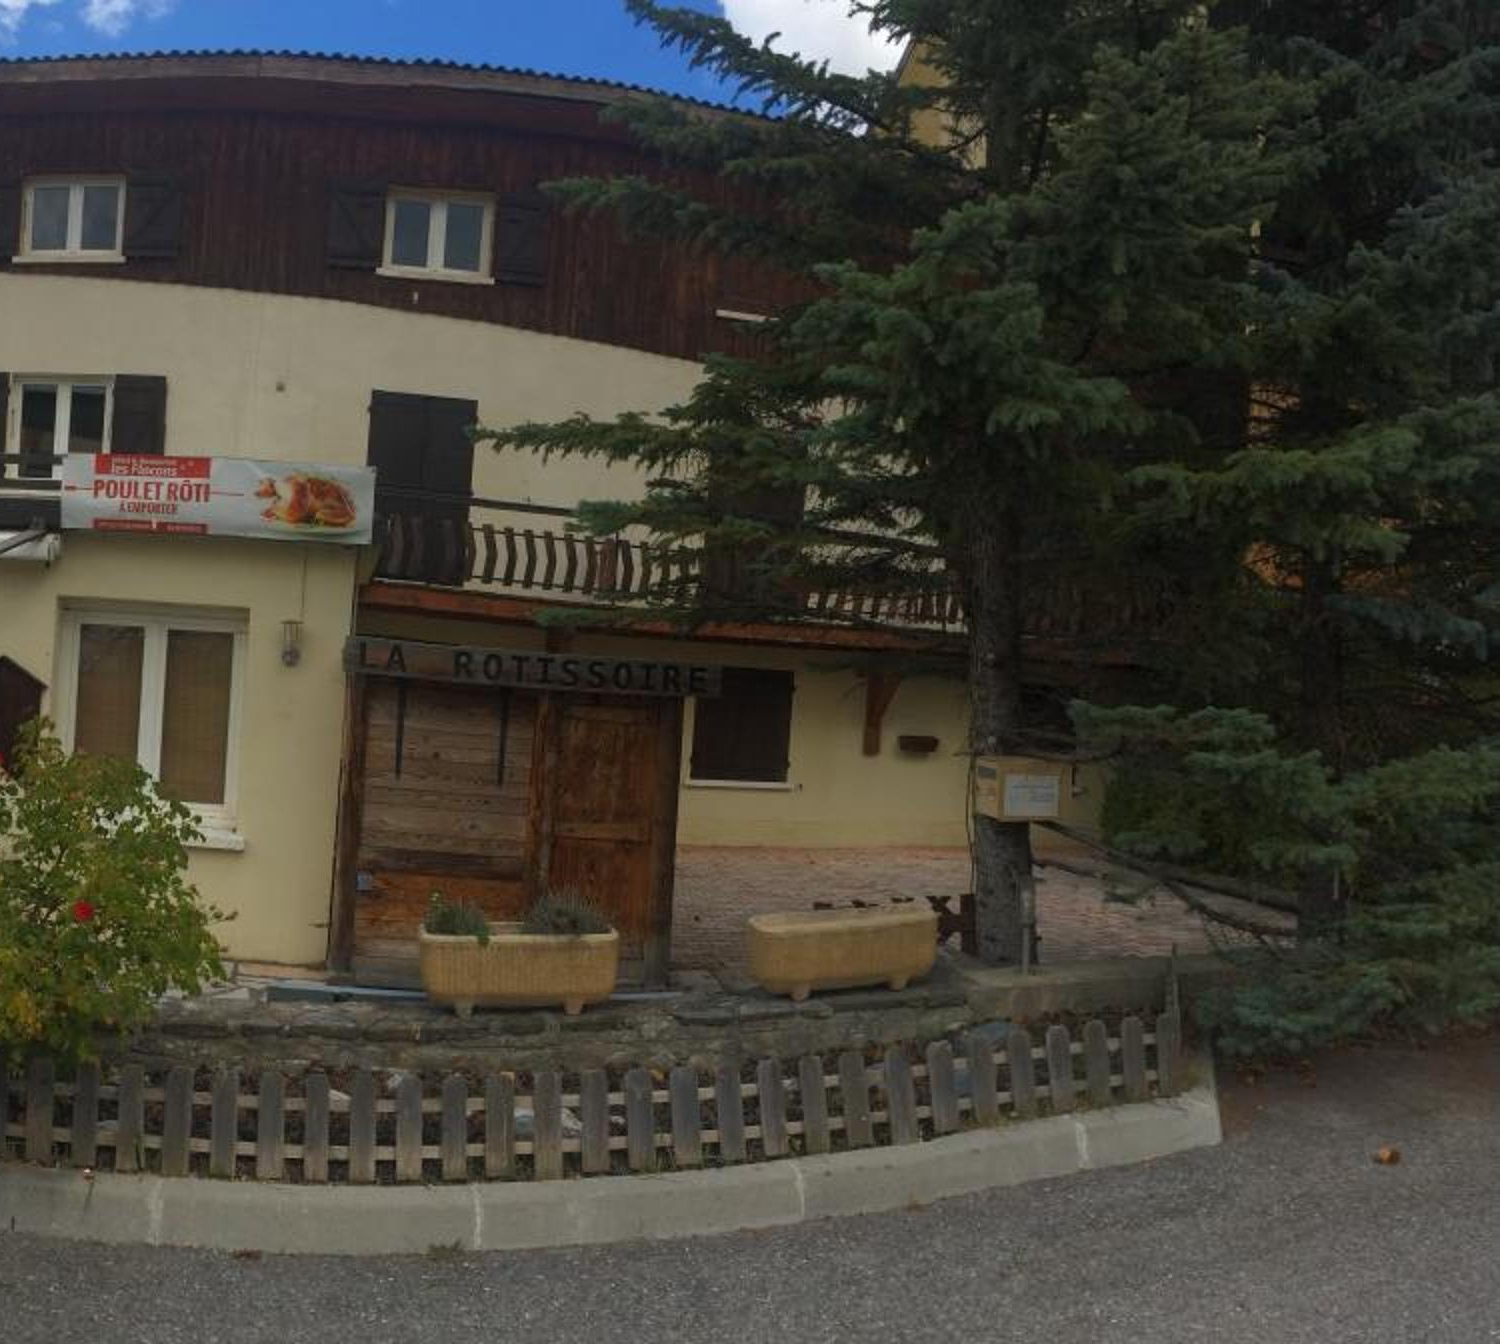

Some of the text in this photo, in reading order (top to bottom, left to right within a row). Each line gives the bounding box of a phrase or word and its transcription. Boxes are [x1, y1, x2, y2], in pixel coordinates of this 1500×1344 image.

[94, 480, 210, 502] POULET RÔTI
[358, 642, 708, 693] LA ROTISSOIRE
